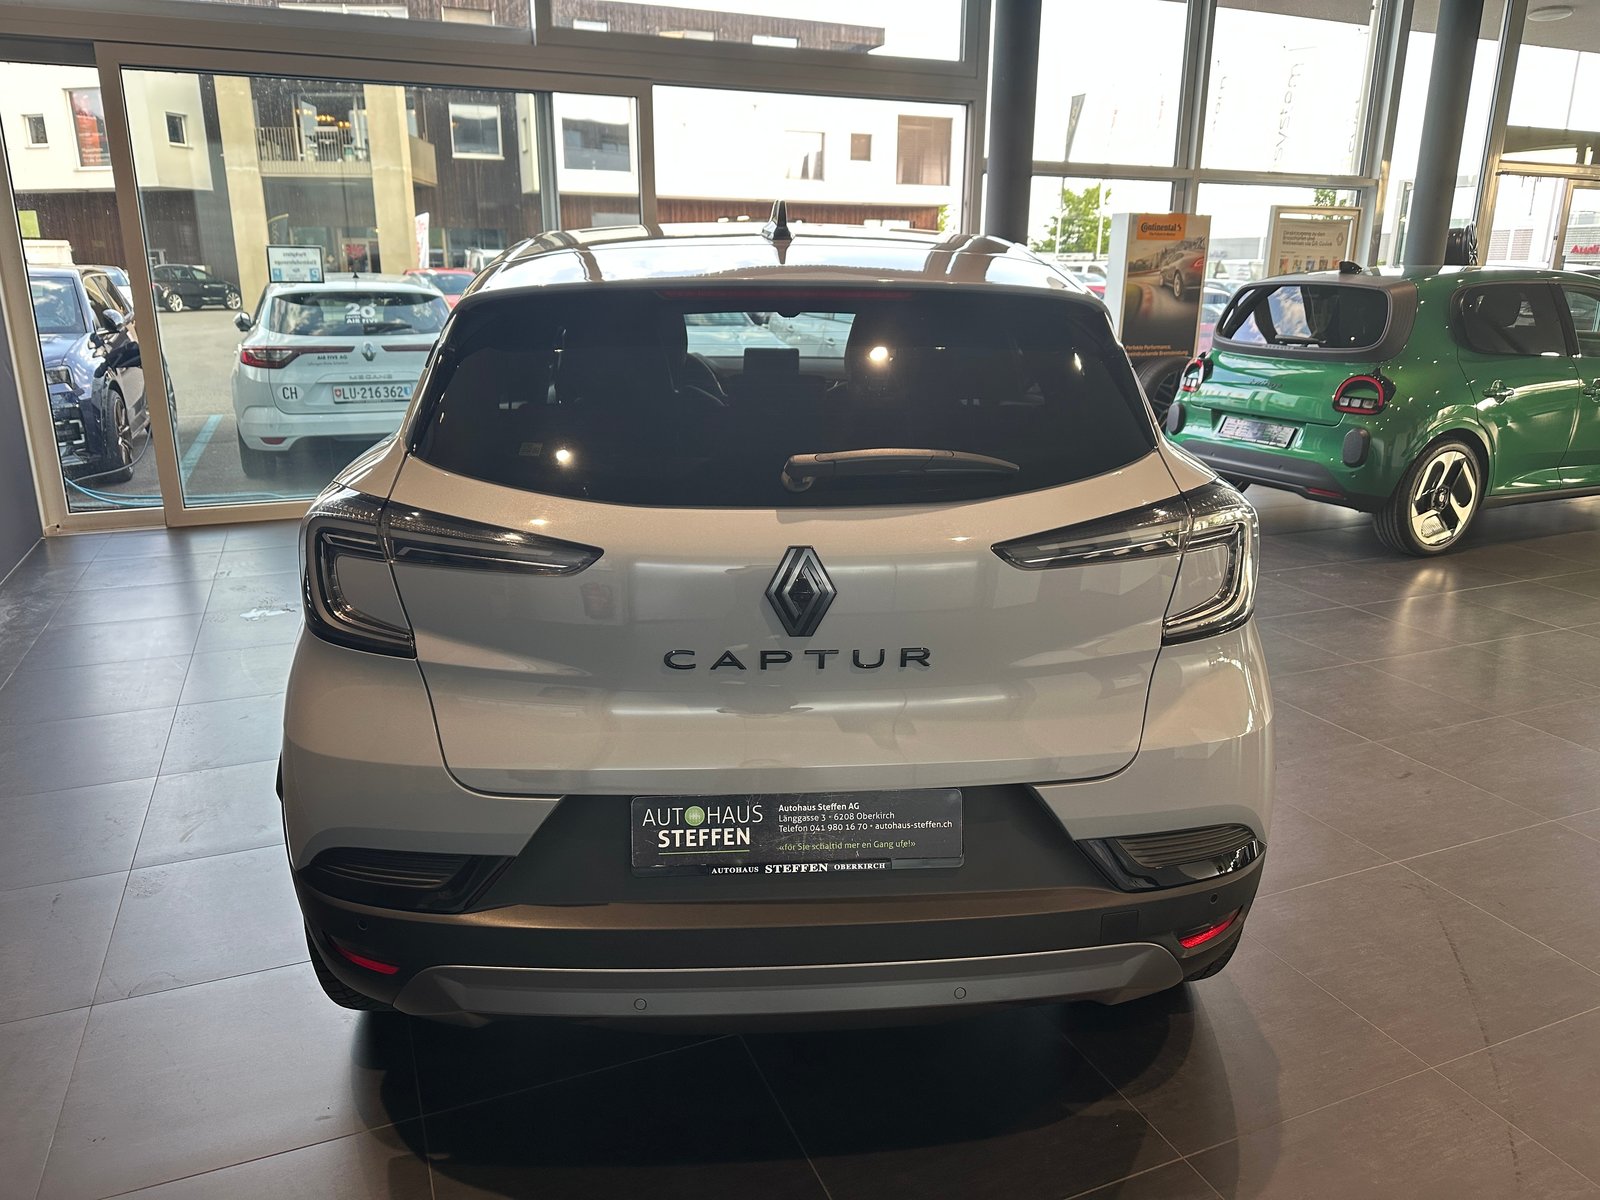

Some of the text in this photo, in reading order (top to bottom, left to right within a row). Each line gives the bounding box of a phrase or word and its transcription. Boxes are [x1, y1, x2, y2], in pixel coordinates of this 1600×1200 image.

[1140, 222, 1177, 233] Continental
[282, 386, 298, 400] CH
[663, 647, 931, 671] CAPTUR
[778, 802, 860, 812] Autohaus Steffen AG
[778, 813, 820, 823] Länggasse
[833, 813, 855, 821] 6208
[856, 812, 895, 820] Oberkirch
[778, 820, 953, 833] Telefon 041 980 16 70 autohaus-steffen.ch
[658, 827, 751, 848] STEFFEN
[797, 842, 811, 851] Sie
[861, 841, 872, 849] en
[873, 841, 894, 850] Gang
[711, 862, 886, 875] AUTOHAUS STEFFEN OBERKIRCH
